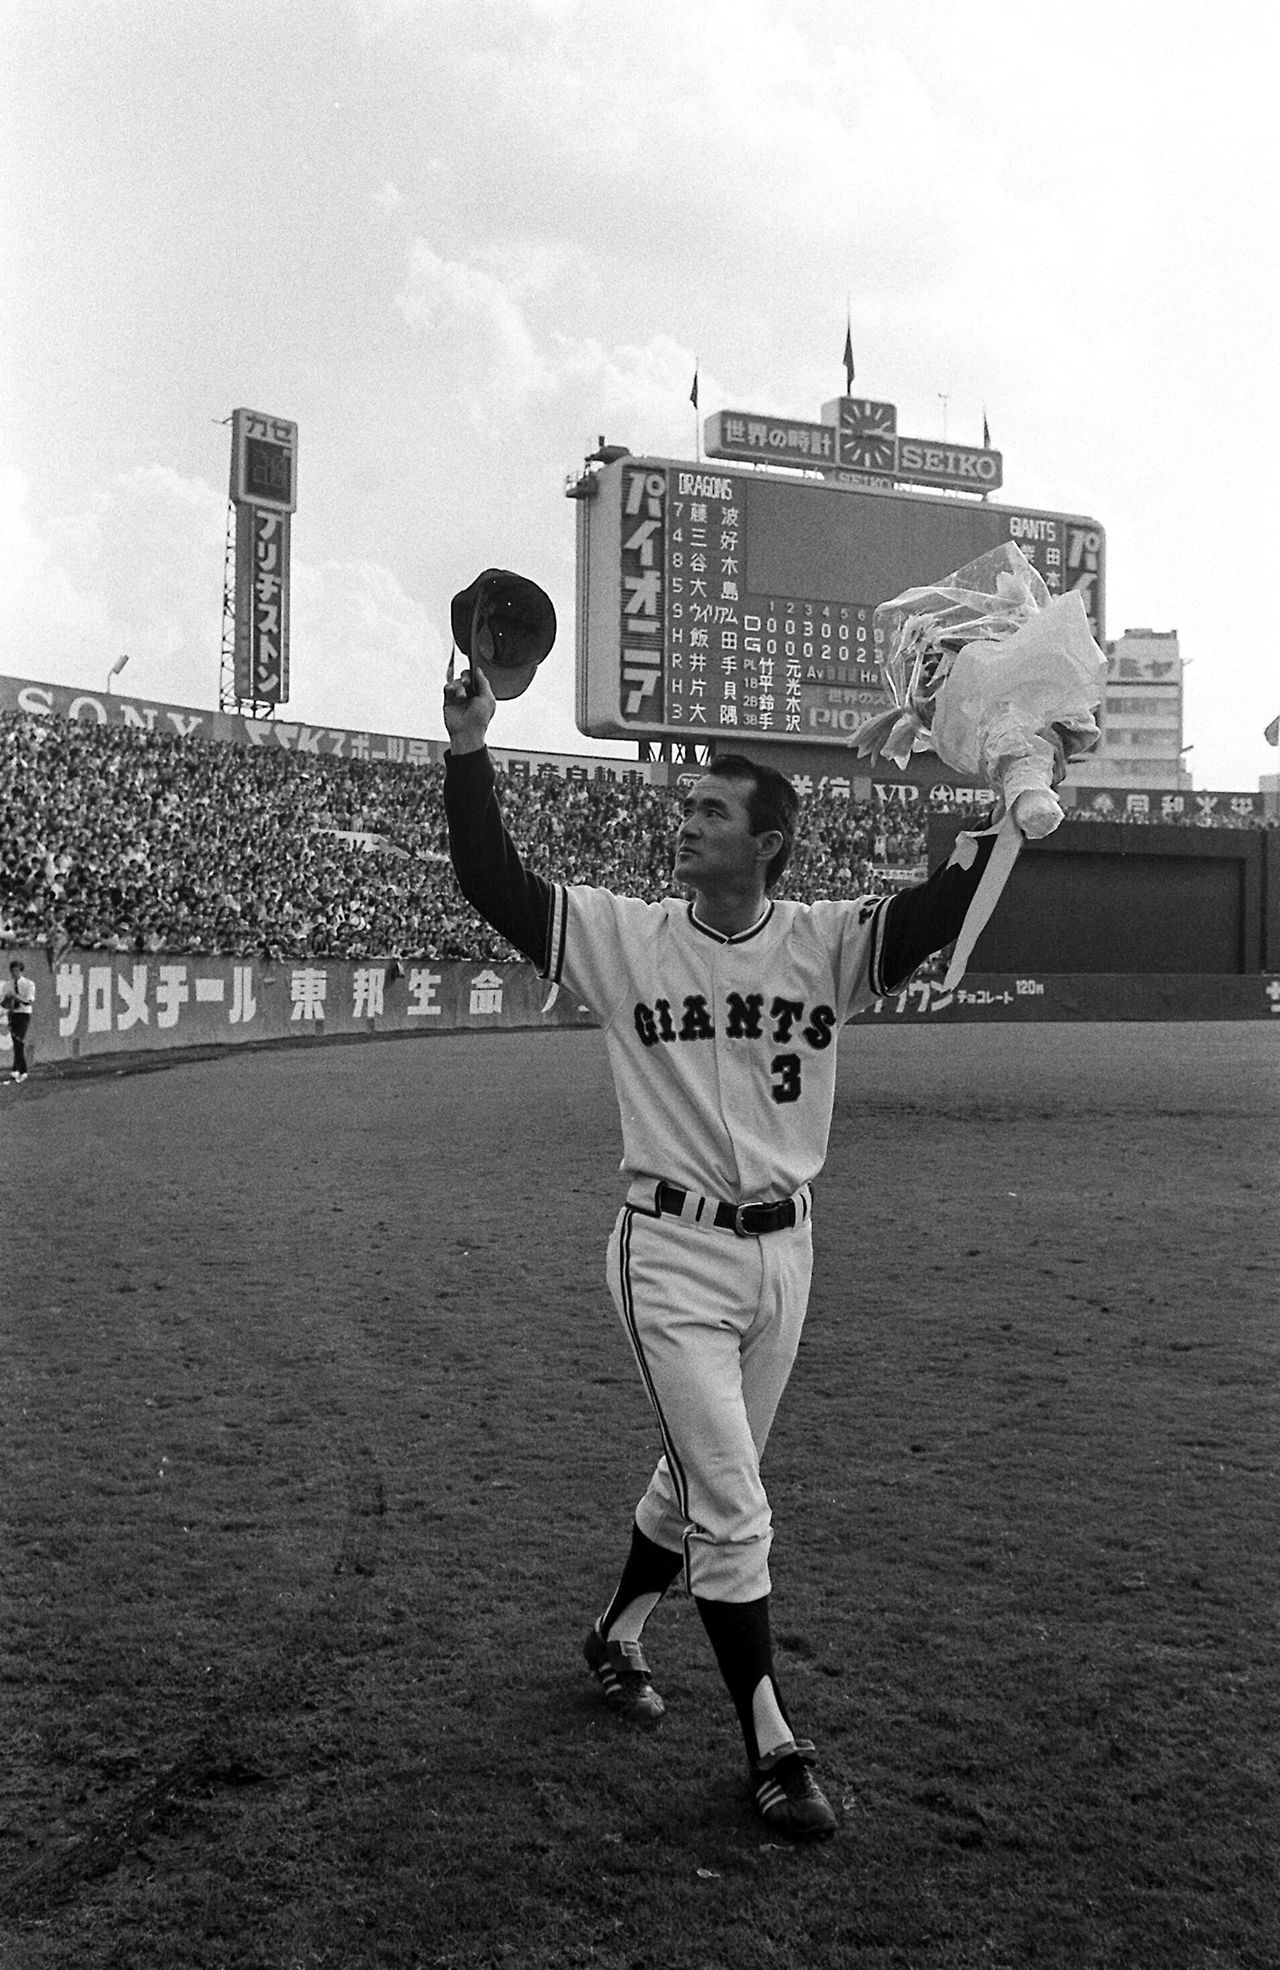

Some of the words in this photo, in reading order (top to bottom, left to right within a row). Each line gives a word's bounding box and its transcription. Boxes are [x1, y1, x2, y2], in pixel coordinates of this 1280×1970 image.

[724, 420, 832, 456] 世界の時計
[901, 445, 996, 479] SEIKO
[679, 472, 732, 500] DRAGONS
[673, 502, 683, 517] 7
[672, 528, 683, 542] 4
[690, 528, 738, 550] 三好
[673, 552, 682, 568] 8
[690, 552, 738, 575] 谷木
[623, 472, 666, 713] パイオニア
[673, 578, 682, 592] 5
[768, 601, 774, 612] 1
[787, 602, 794, 614] 2
[804, 604, 812, 616] 3
[822, 606, 830, 617] 4
[672, 628, 682, 642] H
[690, 628, 738, 650] 飯田
[766, 618, 776, 633] 0
[785, 620, 795, 634] 0
[802, 622, 813, 636] 3
[822, 623, 830, 638] 0
[839, 625, 848, 640] 0
[856, 626, 866, 642] 0
[744, 637, 760, 652] G
[766, 640, 776, 654] 0
[785, 641, 795, 656] 0
[803, 642, 813, 658] 0
[822, 644, 830, 660] 2
[839, 646, 848, 660] 0
[856, 648, 866, 662] 2
[672, 653, 682, 668] R
[690, 653, 738, 674] 井手
[672, 678, 682, 694] H
[672, 704, 682, 718] 3
[56, 963, 257, 1037] サロメチール
[290, 968, 503, 1020] 東邦生命
[956, 990, 1014, 1005] チョコレート
[634, 992, 836, 1050] GIANTS
[771, 1053, 802, 1105] 3
